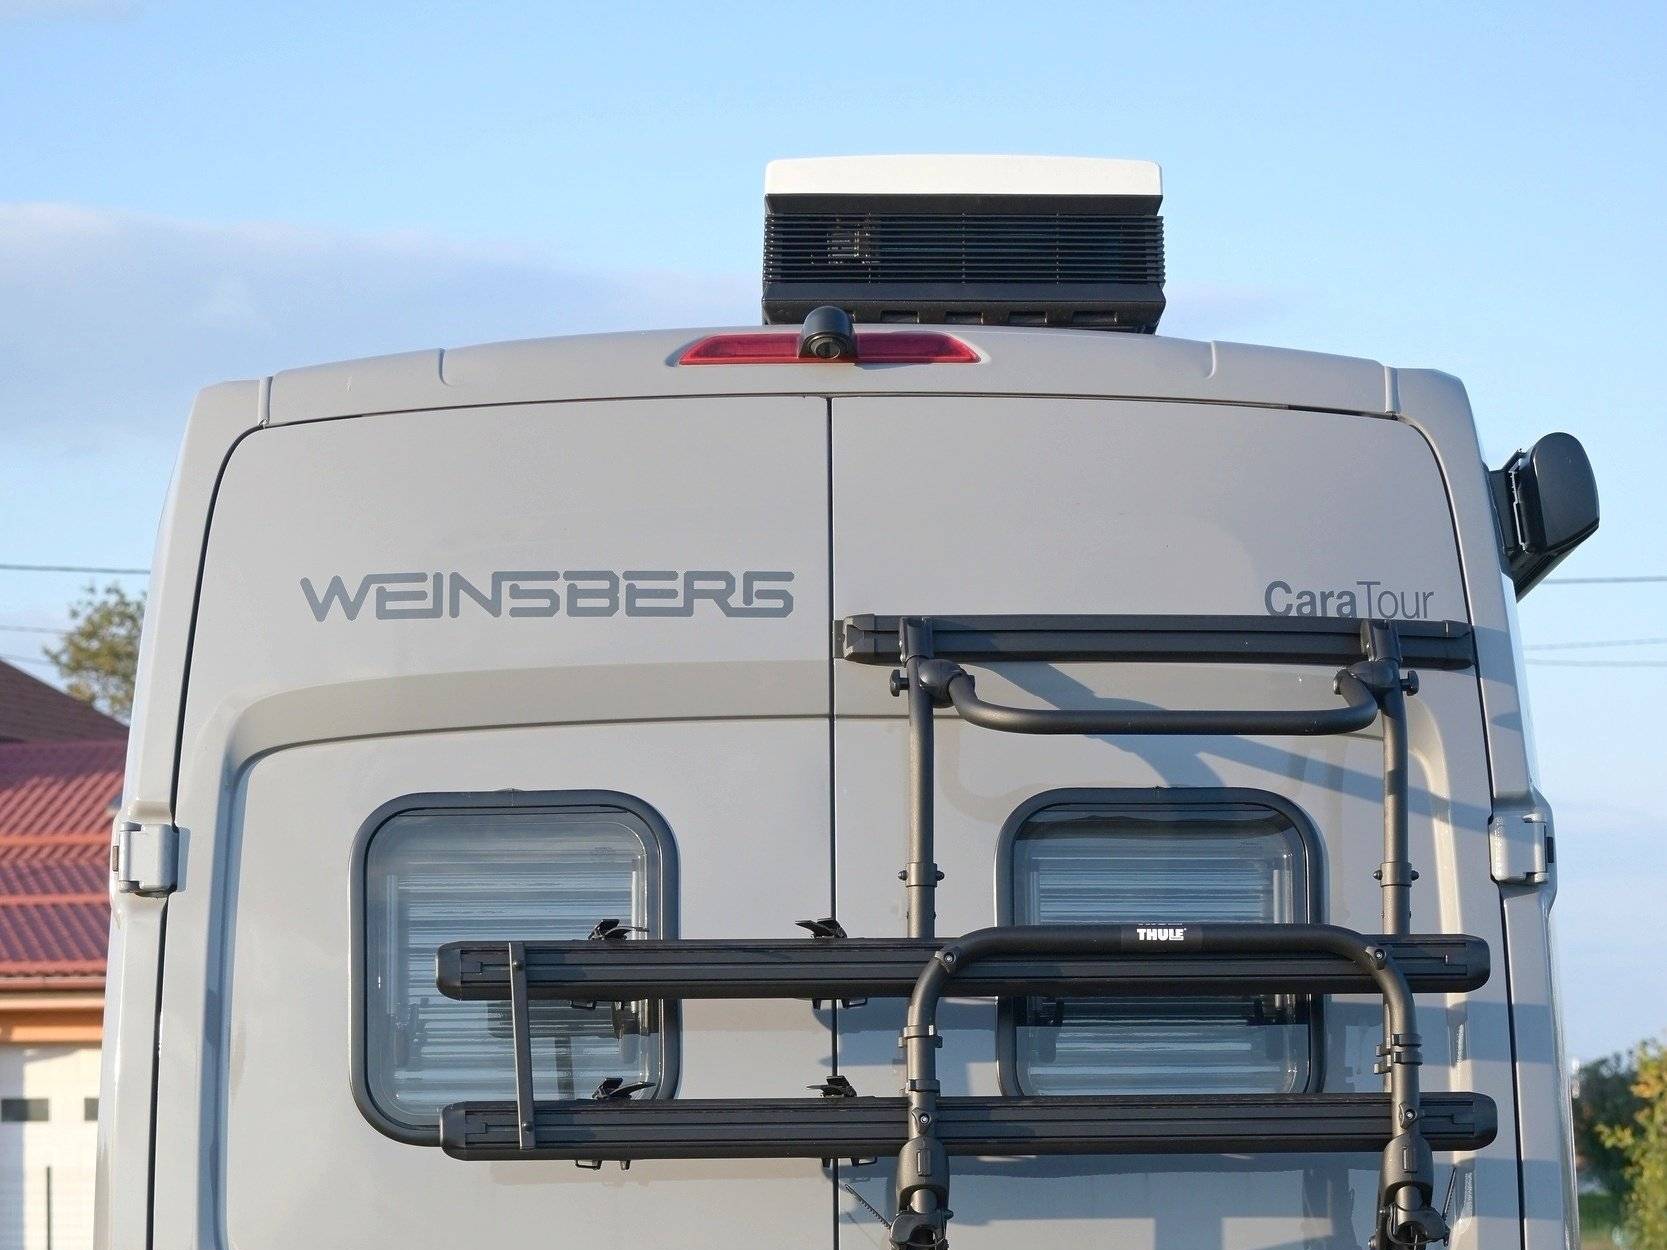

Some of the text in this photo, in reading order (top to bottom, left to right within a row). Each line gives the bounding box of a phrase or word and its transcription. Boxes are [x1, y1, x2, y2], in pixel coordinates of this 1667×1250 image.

[300, 571, 795, 622] WEINSBERG
[1264, 580, 1435, 619] CaraTour
[1136, 928, 1185, 942] THULE
